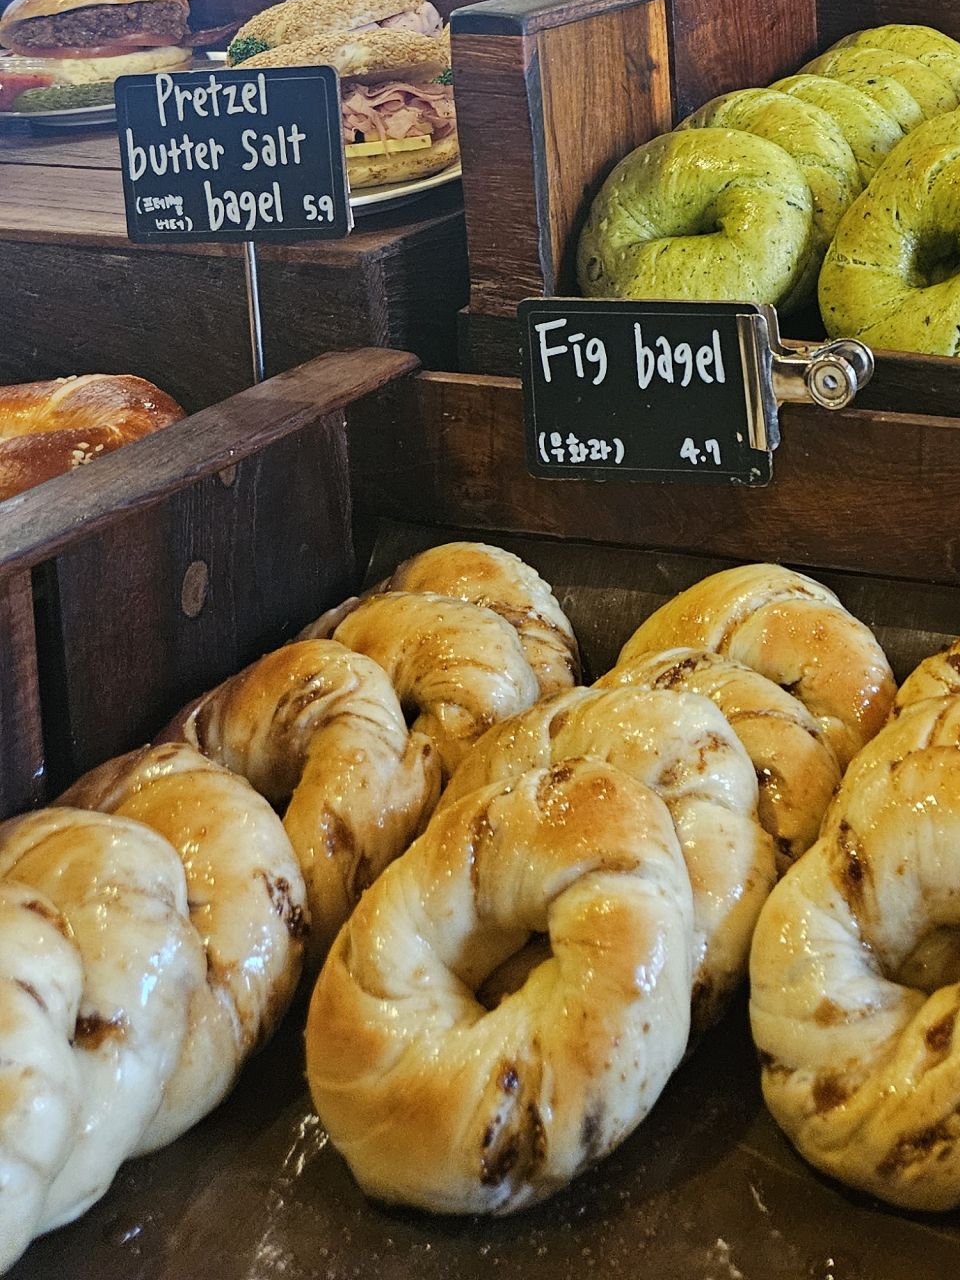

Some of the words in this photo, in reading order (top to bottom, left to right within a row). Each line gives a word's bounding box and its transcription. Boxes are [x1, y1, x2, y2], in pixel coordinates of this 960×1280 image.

[156, 73, 268, 127] Pretzel
[126, 128, 224, 181] butter
[242, 124, 306, 171] Salt
[204, 180, 283, 231] bagel
[303, 195, 334, 222] 5.9
[535, 319, 608, 385] Fig
[633, 322, 725, 390] bagel
[679, 437, 722, 465] 4.7
